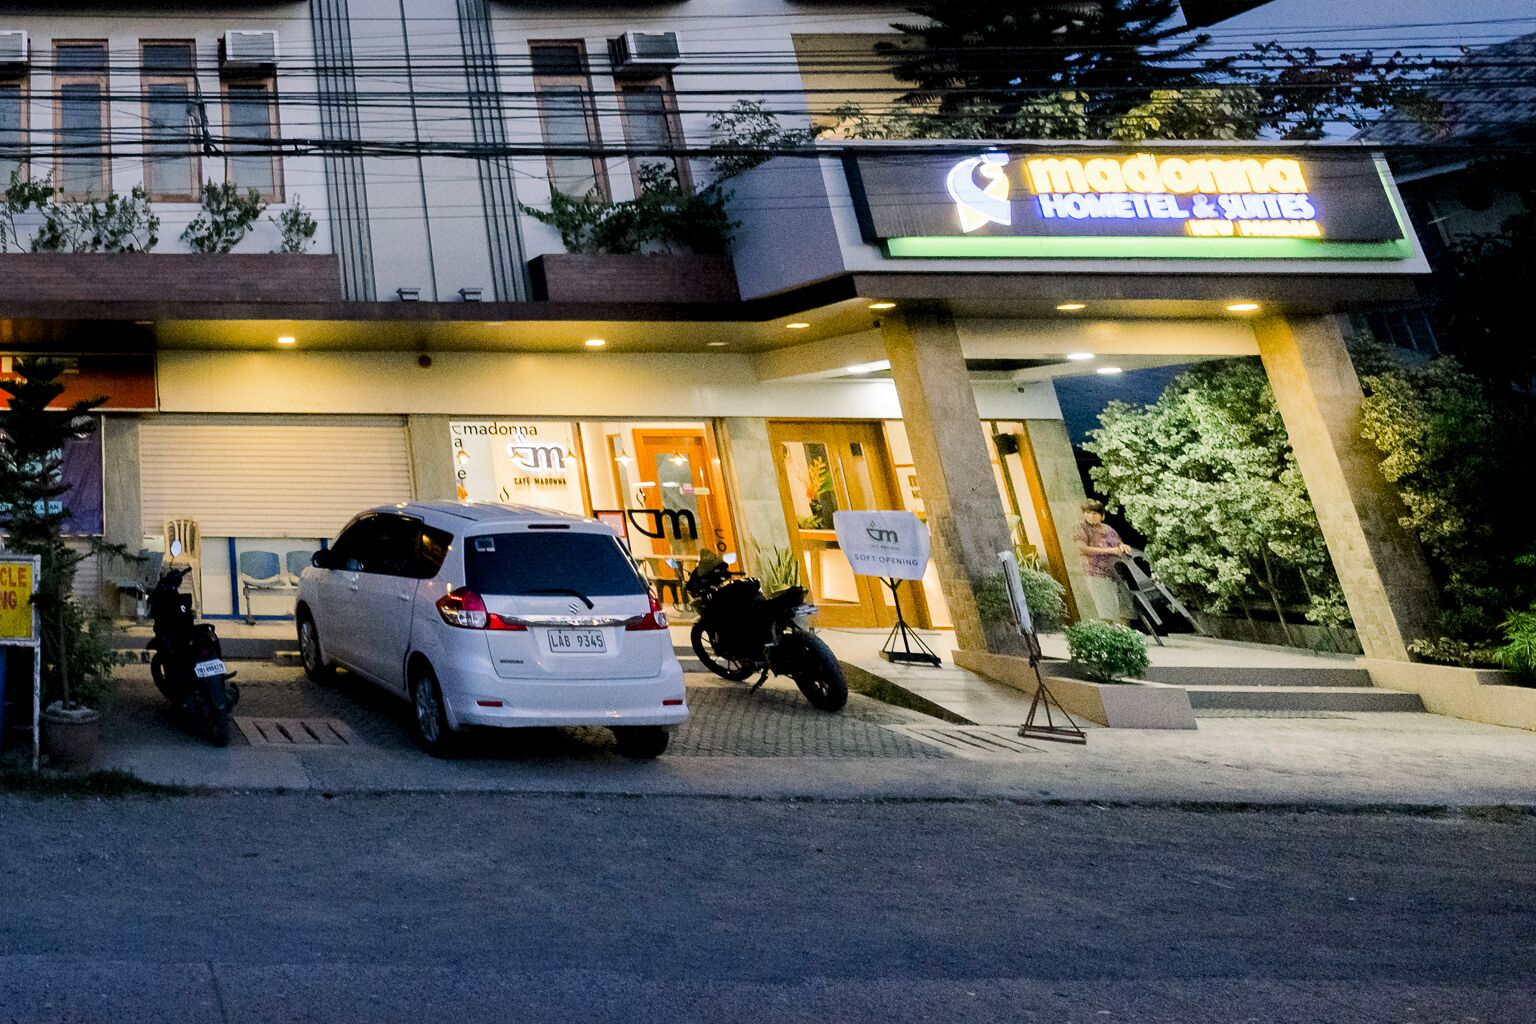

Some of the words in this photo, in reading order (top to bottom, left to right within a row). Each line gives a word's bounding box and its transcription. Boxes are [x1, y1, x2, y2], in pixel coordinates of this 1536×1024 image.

[1026, 153, 1309, 194] madonna
[1037, 193, 1191, 219] HOMETEL
[1192, 193, 1220, 218] &
[1218, 193, 1316, 220] SUITES
[464, 421, 538, 436] madonna
[534, 477, 567, 486] MADONNA
[854, 553, 876, 562] SOFT
[878, 555, 919, 567] OPENING
[550, 634, 571, 648] LAB
[577, 635, 604, 648] 9345
